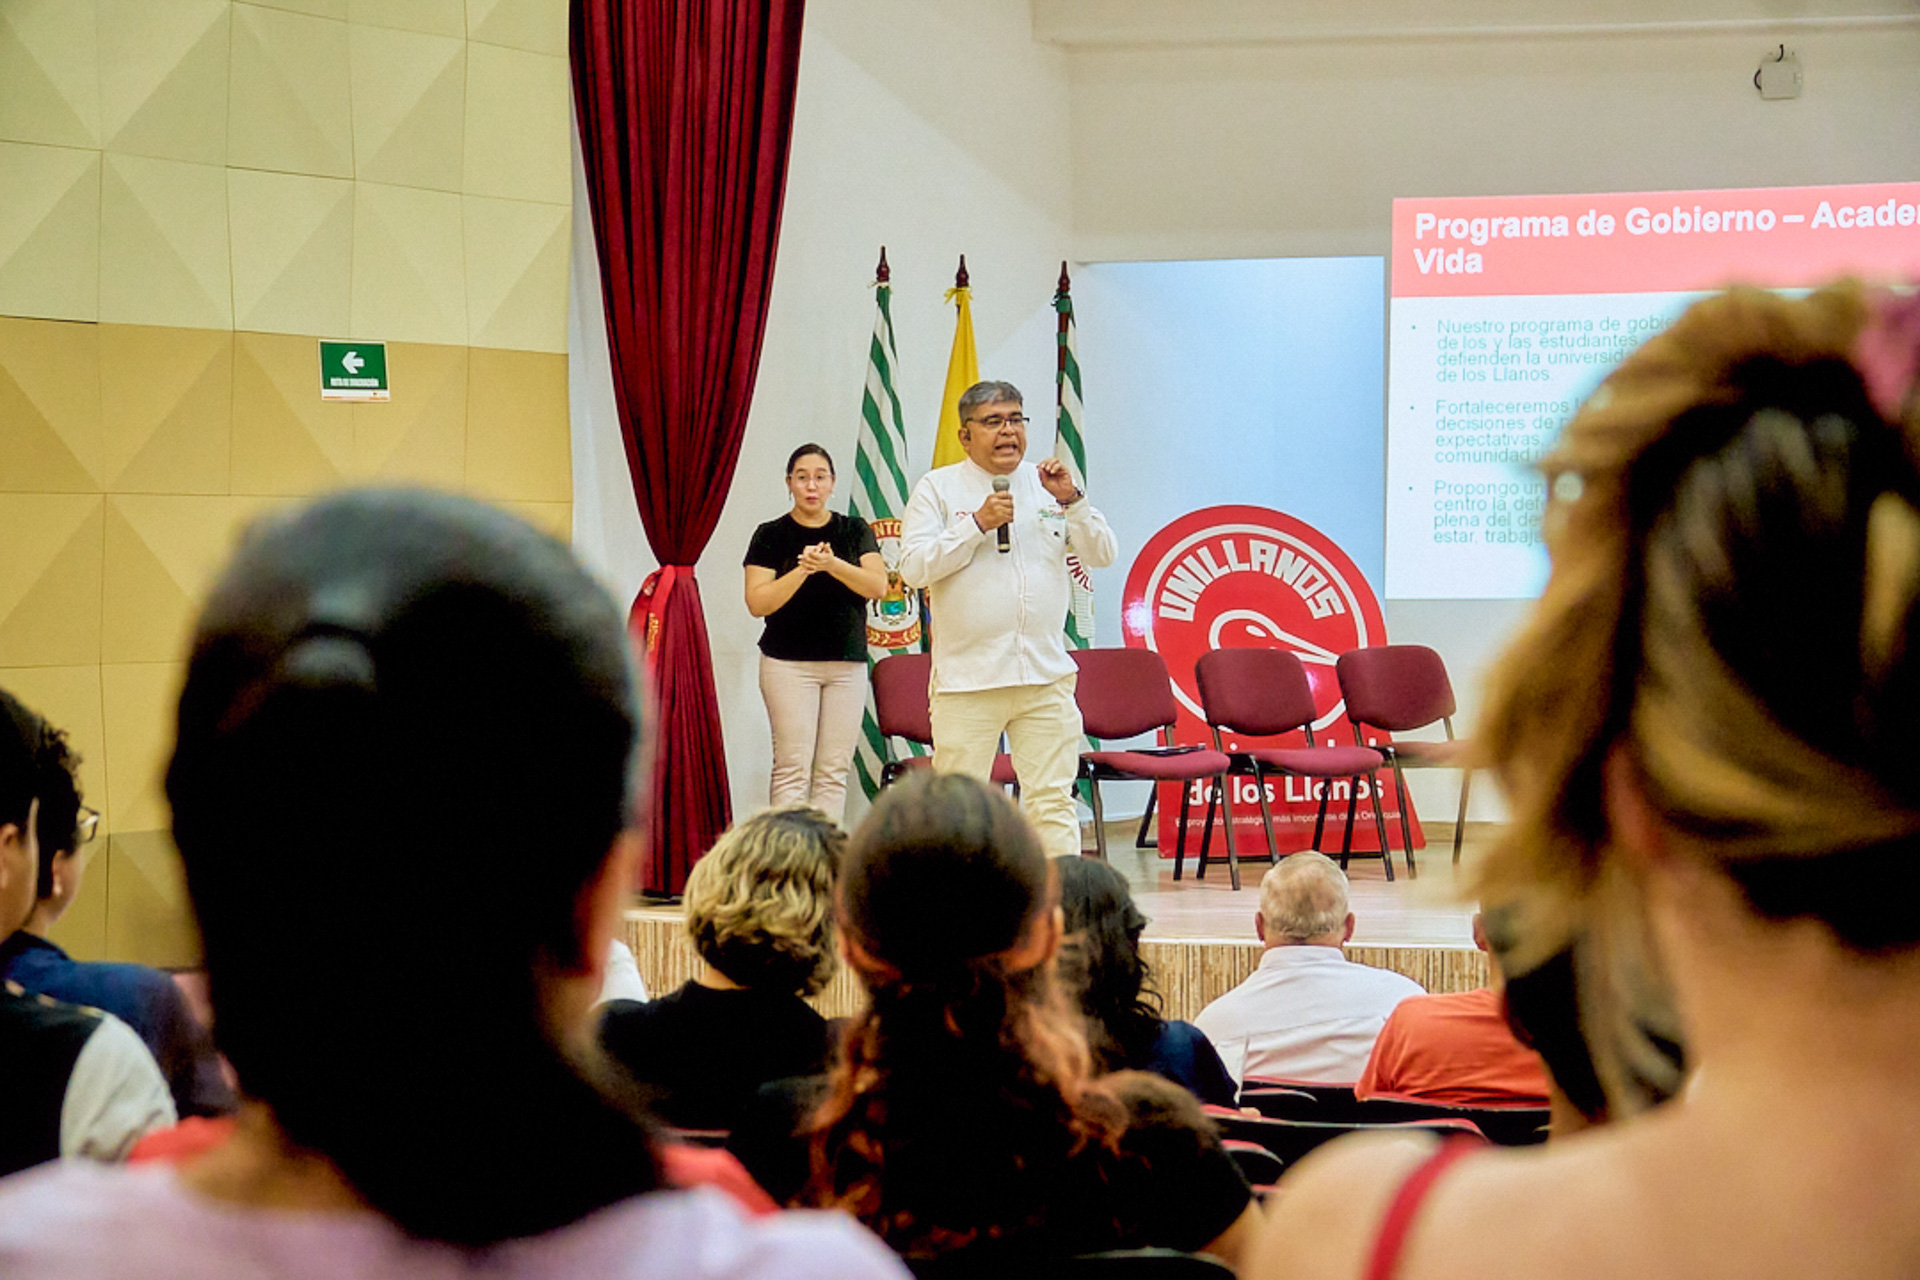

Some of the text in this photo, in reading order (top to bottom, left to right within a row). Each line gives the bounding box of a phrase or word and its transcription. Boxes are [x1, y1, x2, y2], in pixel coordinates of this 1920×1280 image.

[1415, 212, 1569, 246] Programa
[1576, 209, 1616, 236] de
[1625, 205, 1777, 235] Gobierno
[1810, 198, 1920, 229] Acade
[1413, 247, 1483, 275] Vida
[1437, 319, 1504, 334] Nuestro
[1510, 319, 1594, 336] programa
[1599, 317, 1621, 331] de
[1437, 335, 1458, 350] de
[1462, 335, 1487, 350] los
[1493, 337, 1503, 352] y
[1509, 333, 1532, 349] las
[1436, 348, 1626, 366] defienden la universid
[1436, 367, 1457, 382] de
[1462, 367, 1487, 382] los
[1435, 400, 1570, 415] Fortaleceremos
[1435, 416, 1526, 431] decisiones
[1532, 415, 1554, 430] de
[1435, 448, 1530, 463] comunidad
[1434, 480, 1520, 498] Propongo
[1434, 496, 1543, 512] centro la def
[1434, 511, 1541, 530] plena del de
[1159, 539, 1346, 622] UNILLANOS
[1233, 776, 1276, 804] los
